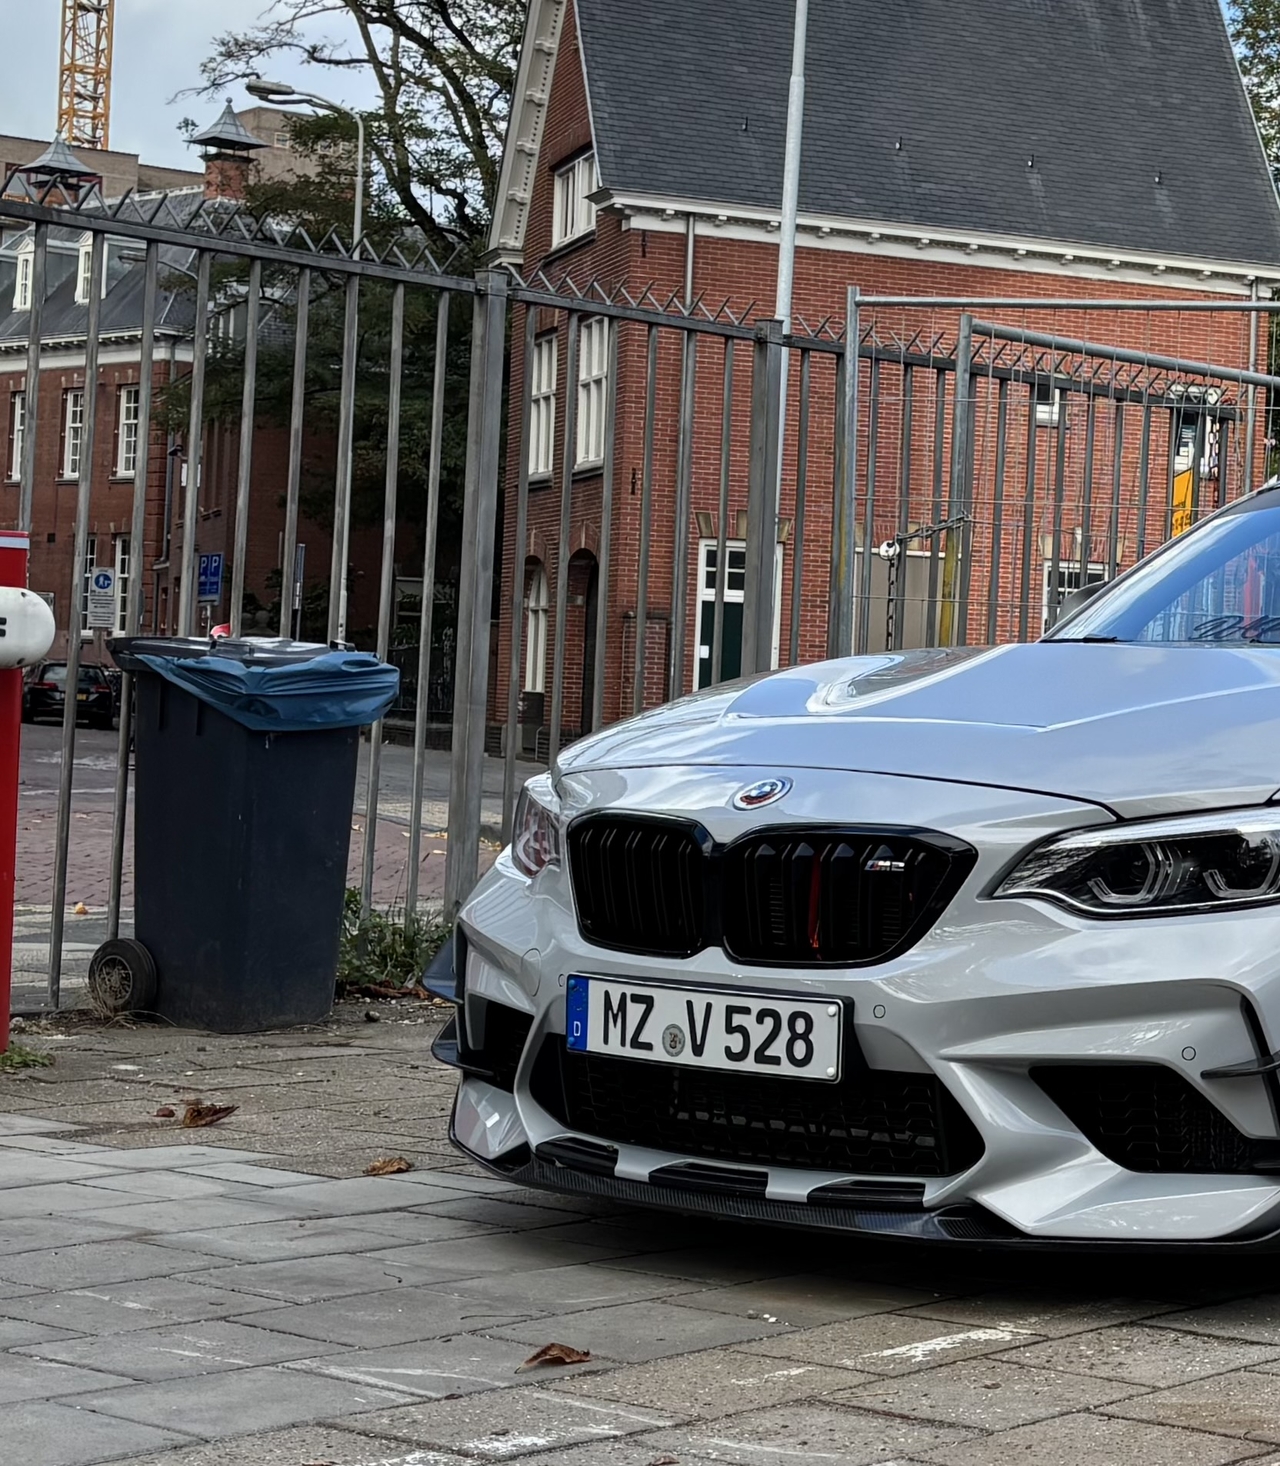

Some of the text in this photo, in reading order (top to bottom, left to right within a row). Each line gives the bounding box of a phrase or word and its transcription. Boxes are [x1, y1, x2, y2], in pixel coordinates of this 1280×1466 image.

[200, 556, 220, 573] P P
[875, 860, 905, 872] M2
[573, 1021, 581, 1037] D
[603, 990, 814, 1068] MZ V 528
